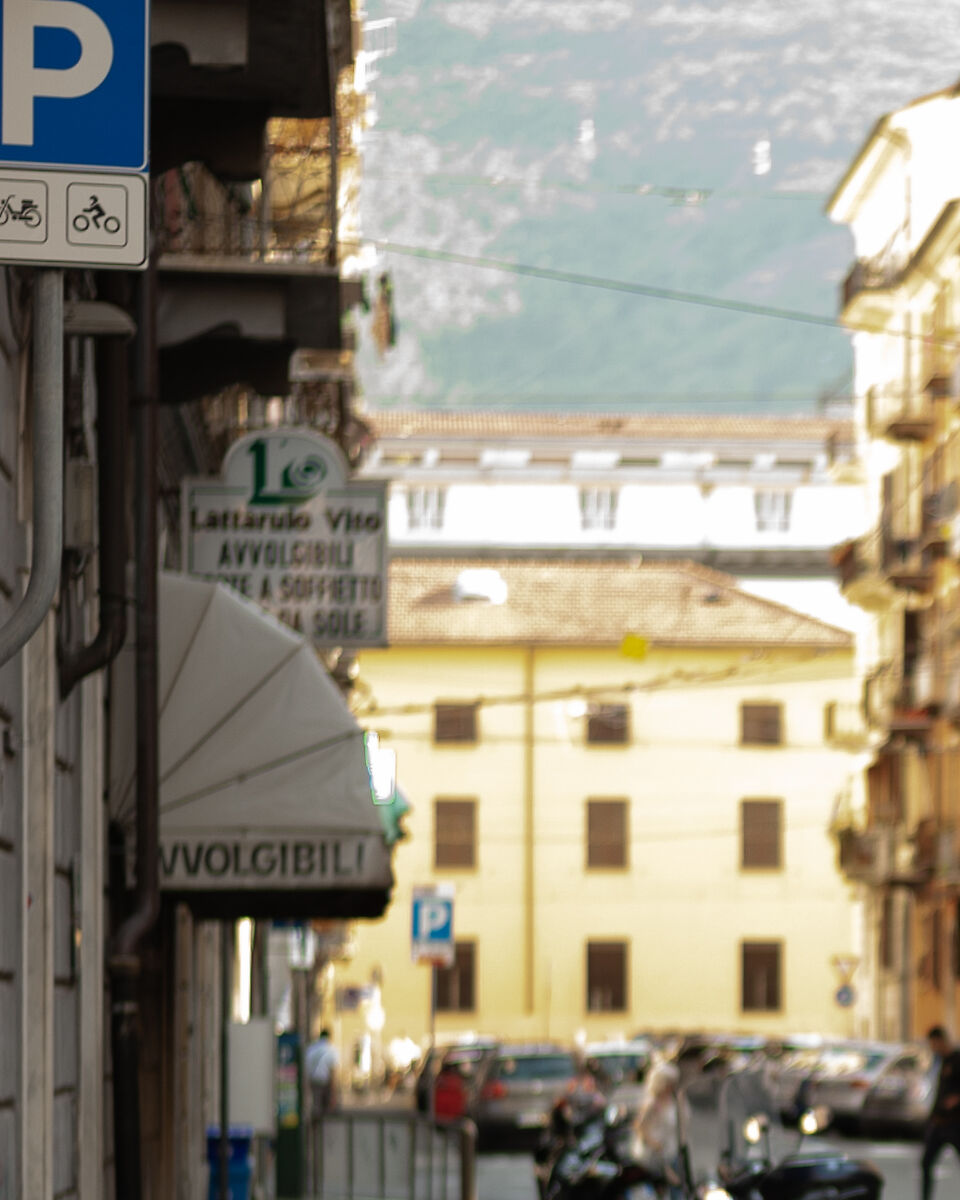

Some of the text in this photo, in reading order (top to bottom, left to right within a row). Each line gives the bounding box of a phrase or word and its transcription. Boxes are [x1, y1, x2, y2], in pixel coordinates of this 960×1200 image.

[1, 0, 114, 147] P
[326, 506, 381, 532] Vito
[218, 540, 353, 568] AVVOLGIBILI
[313, 609, 365, 638] SOLE
[156, 841, 366, 877] VVOLGIBILI
[420, 903, 447, 939] P
